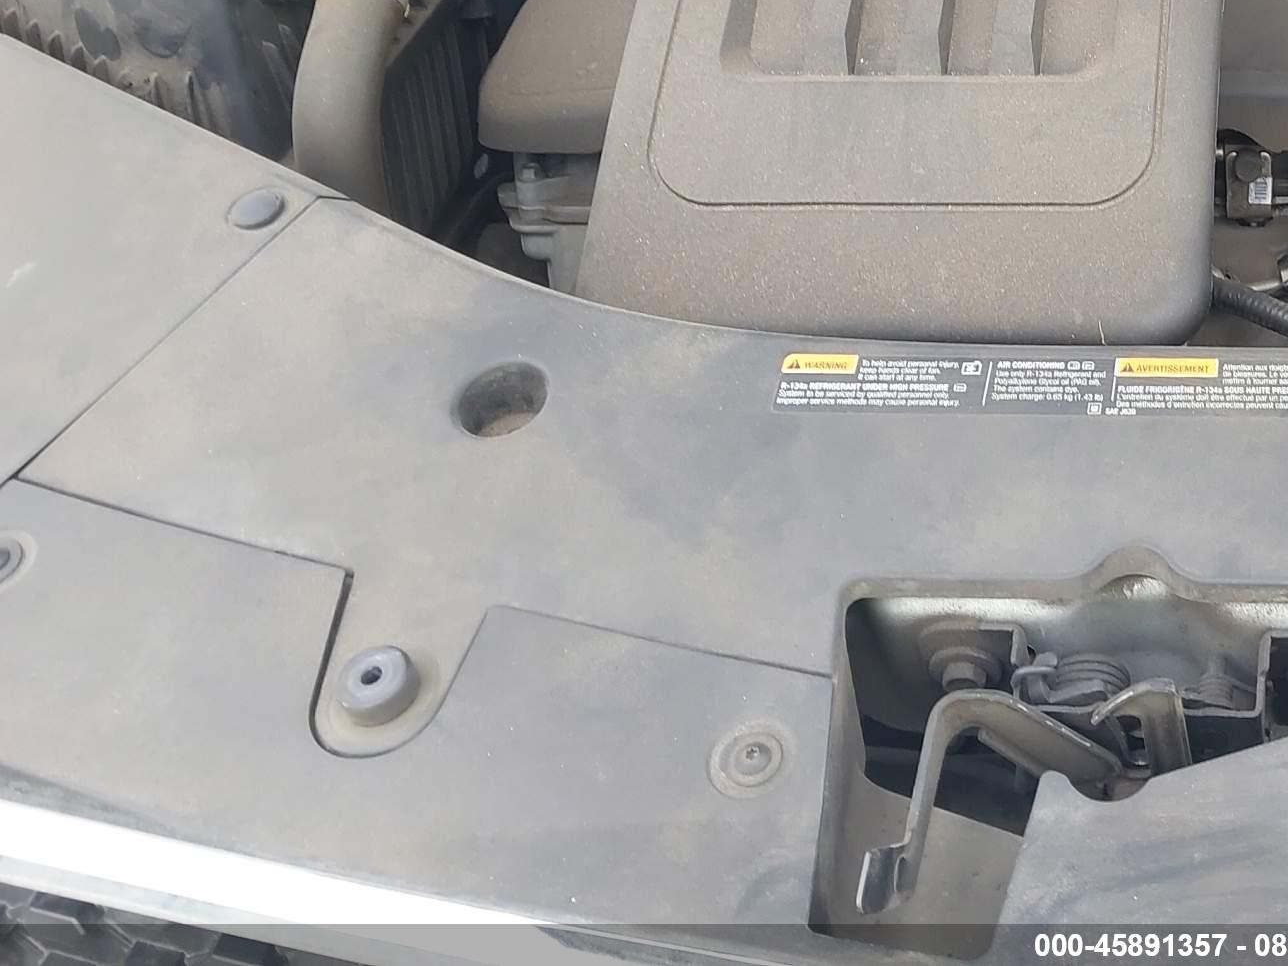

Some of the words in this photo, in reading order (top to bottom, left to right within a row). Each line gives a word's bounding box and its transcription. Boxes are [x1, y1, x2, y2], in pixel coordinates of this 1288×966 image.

[804, 361, 847, 369] WARNING
[1012, 361, 1066, 370] CONDITIONING
[1136, 364, 1209, 373] AVERTISSEMENT
[909, 383, 949, 391] PRESSURE
[1224, 386, 1244, 394] SOUS
